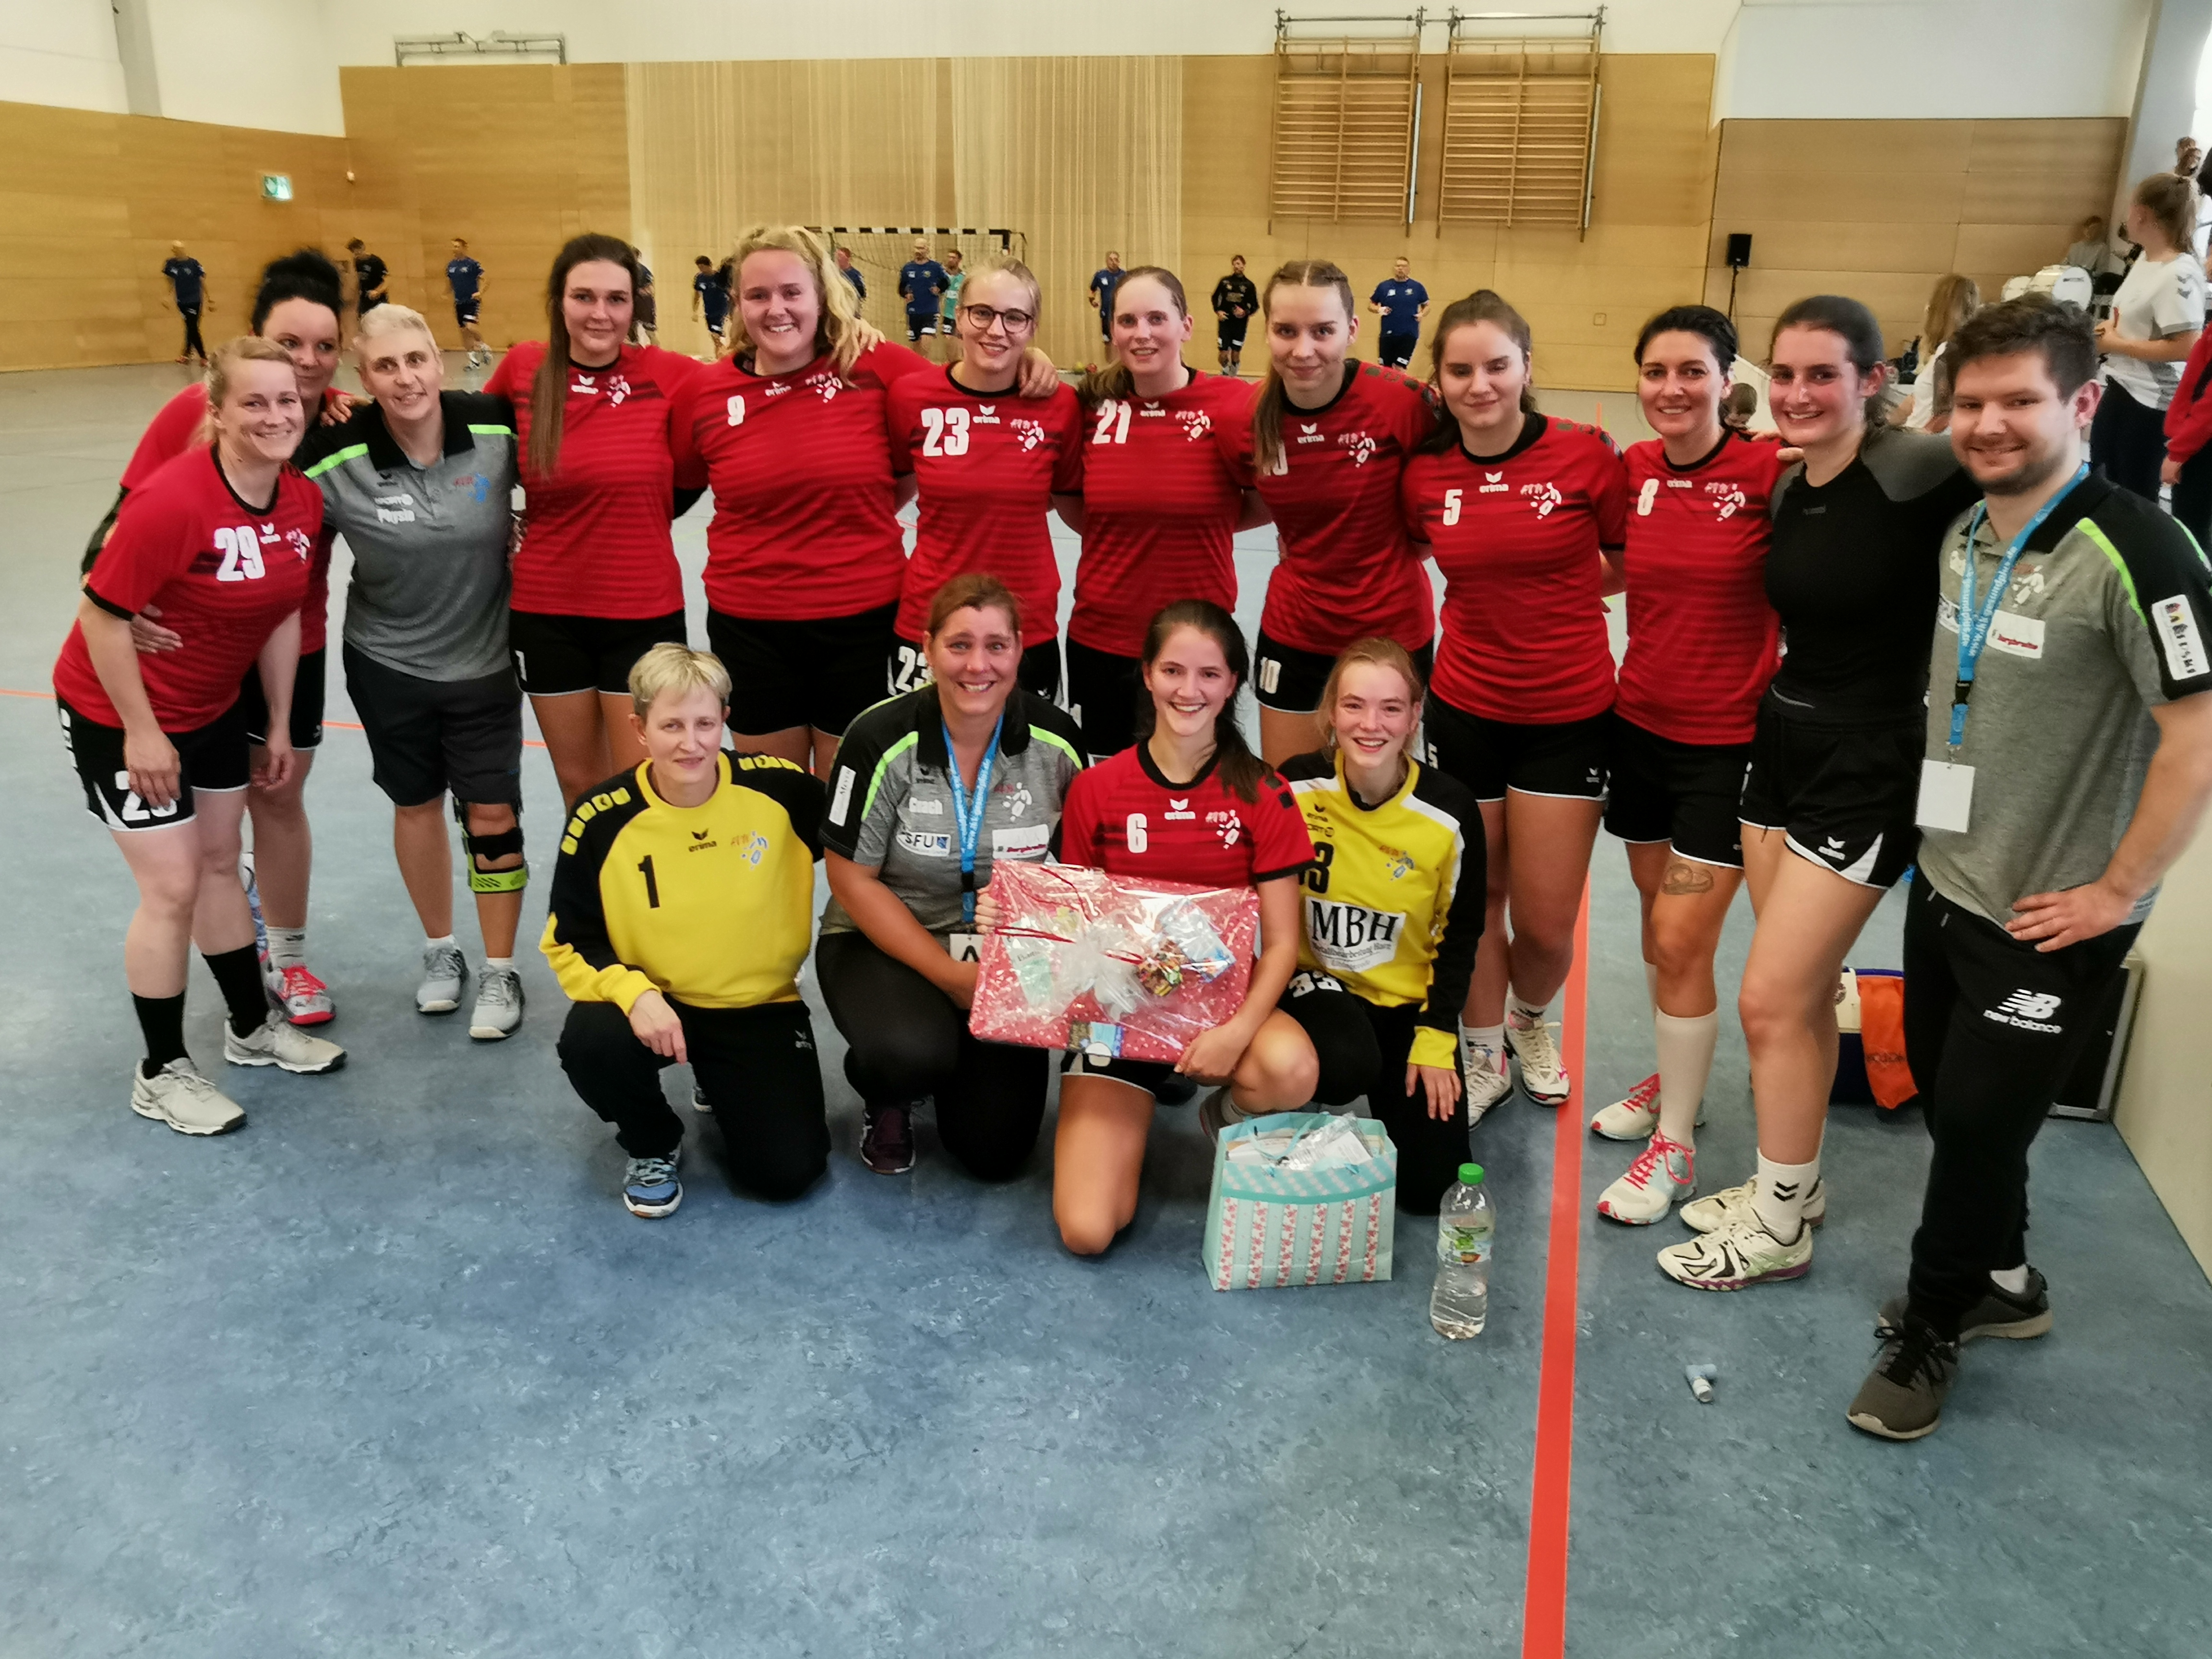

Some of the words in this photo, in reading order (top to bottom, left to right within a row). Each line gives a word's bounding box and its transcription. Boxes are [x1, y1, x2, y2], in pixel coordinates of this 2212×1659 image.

[727, 395, 745, 426] 9
[1092, 399, 1132, 445] 21
[921, 408, 970, 457] 23
[1443, 489, 1463, 526] 5
[1636, 478, 1659, 516] 8
[214, 526, 265, 581] 29
[1259, 656, 1282, 694] 10
[902, 831, 934, 848] SFU
[1127, 813, 1148, 853] 6
[637, 854, 660, 909] 1
[1311, 900, 1399, 948] MBH
[1983, 1010, 2011, 1023] new
[2009, 1015, 2062, 1034] balance
